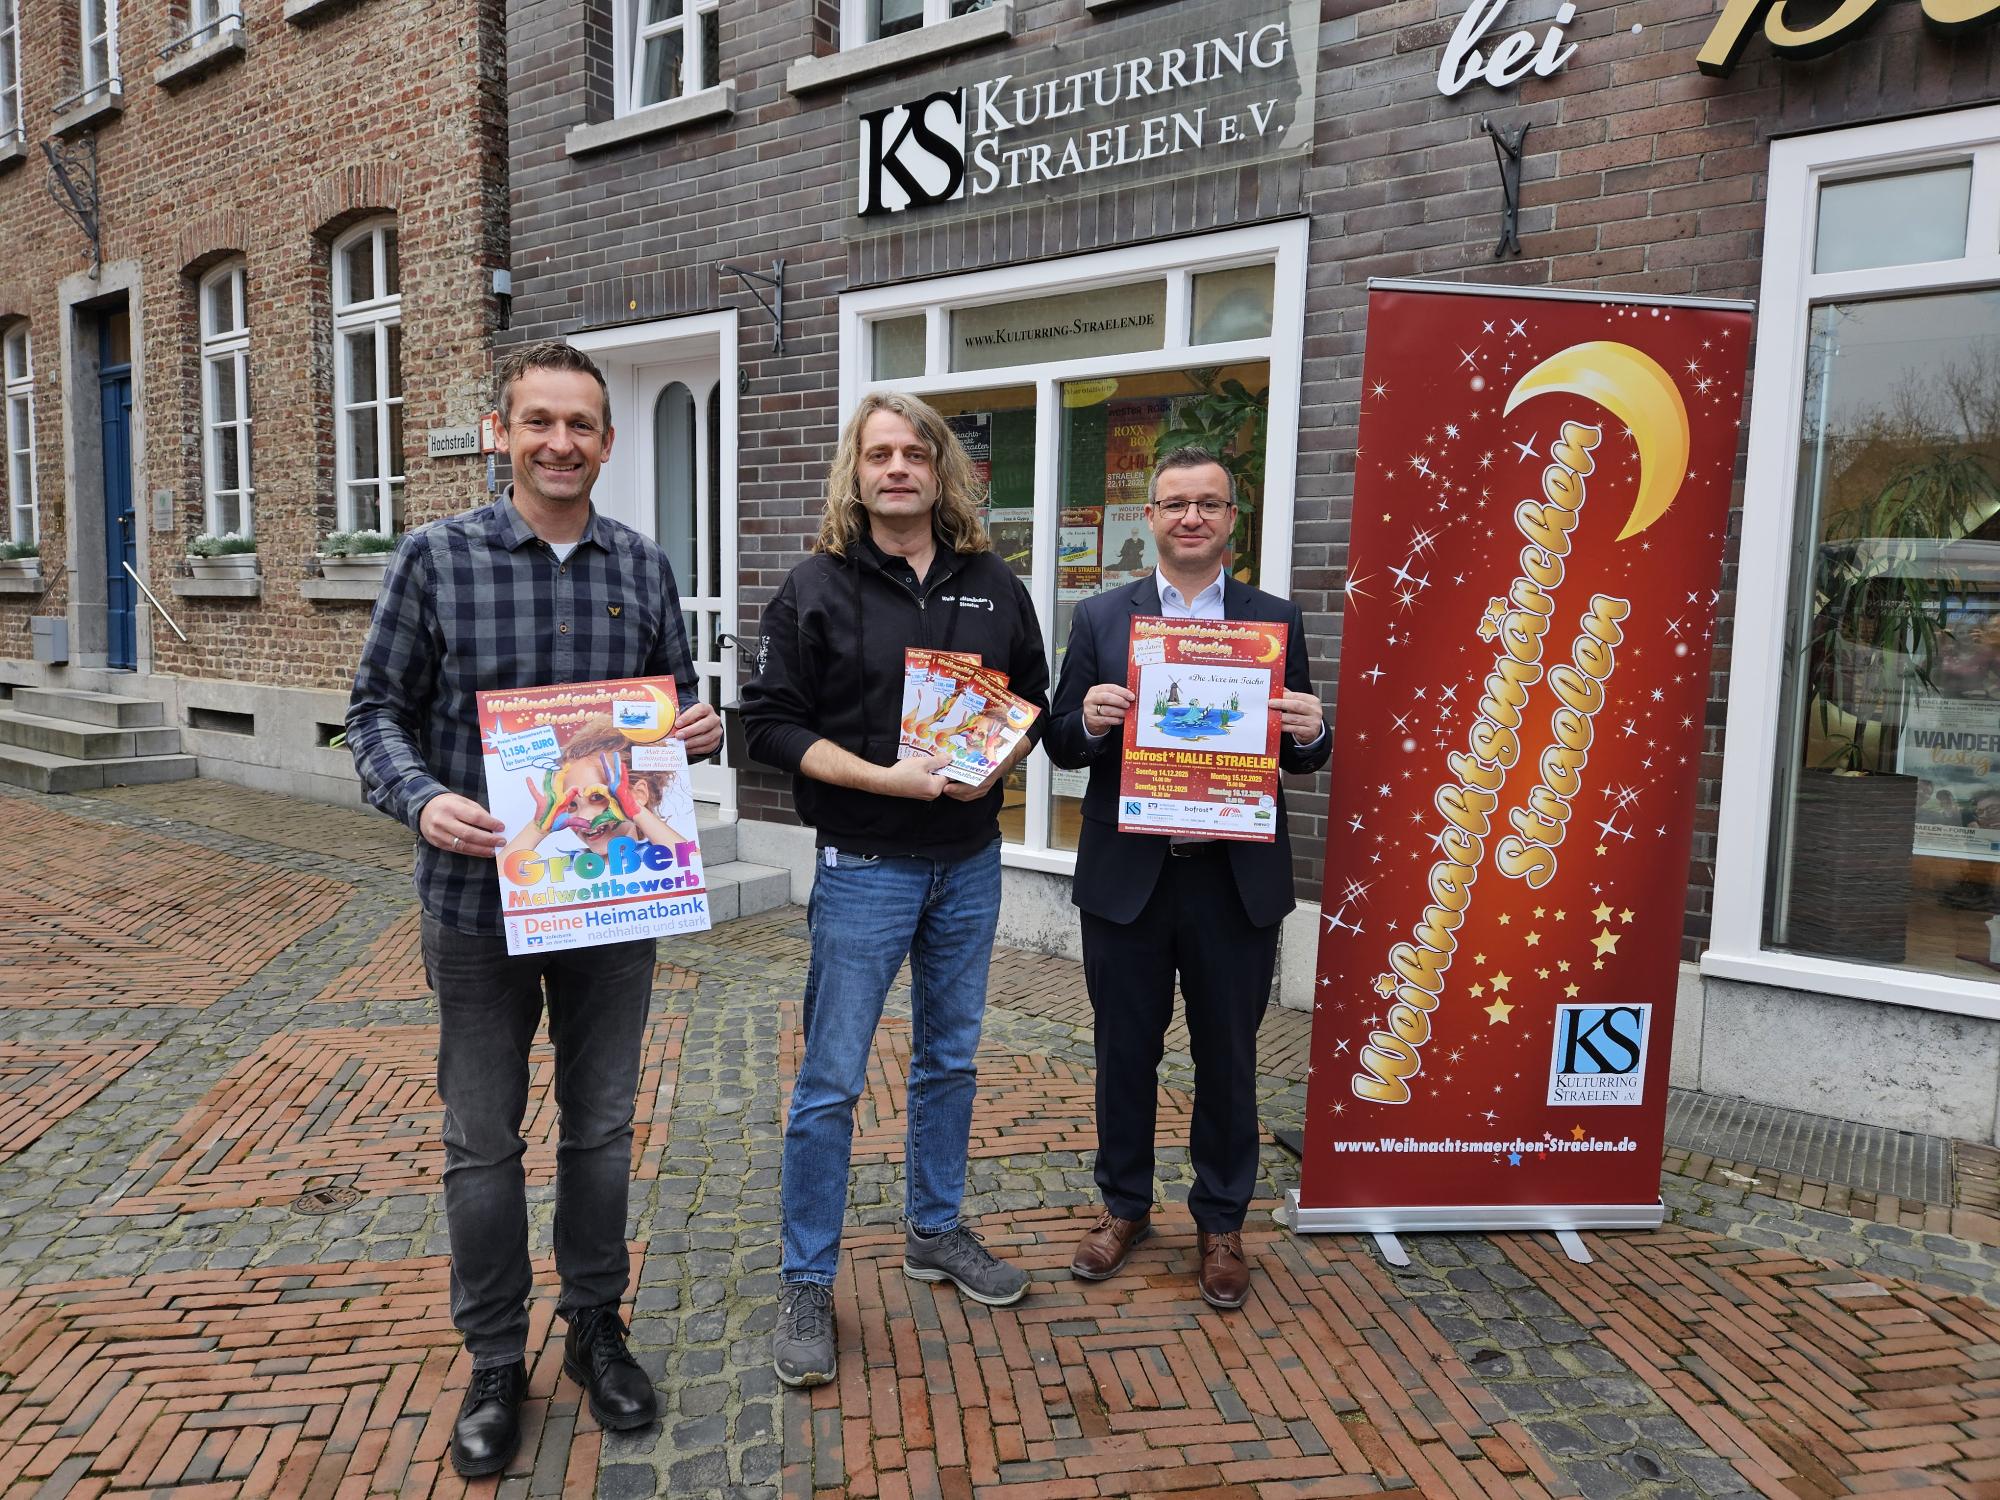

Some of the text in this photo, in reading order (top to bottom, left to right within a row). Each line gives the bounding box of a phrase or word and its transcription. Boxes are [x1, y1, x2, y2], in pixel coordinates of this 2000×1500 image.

[1437, 0, 1579, 96] bei
[973, 22, 1290, 138] KULTURRING
[858, 86, 965, 218] KS
[973, 107, 1206, 197] STRAELEN
[1113, 424, 1144, 438] ROXX
[431, 432, 475, 452] Hochstraße
[1106, 471, 1145, 481] STRAELEN
[1110, 512, 1146, 521] TREPP
[531, 737, 555, 751] EURO
[1495, 594, 1631, 889] Straelen
[1176, 751, 1213, 765] HALLE
[1215, 753, 1276, 769] STRAELEN
[1352, 420, 1602, 1104] Weihnachtsmärchen
[1931, 744, 1991, 777] lustig
[1135, 767, 1158, 777] Sonntag
[1210, 773, 1231, 782] Montag
[1135, 783, 1157, 792] Sonntag
[1125, 802, 1141, 815] KS
[503, 835, 698, 887] Großer
[508, 869, 700, 909] Malwettbewerb
[524, 897, 705, 934] Deine Heimatbank
[587, 915, 707, 941] nachhaltig und stark
[1560, 1006, 1642, 1074] KS
[1556, 1074, 1638, 1088] KULTURRING
[1553, 1088, 1619, 1101] STRAELEN
[1333, 1136, 1638, 1154] www.Weihnachtsmaerchen-Straelen.de
